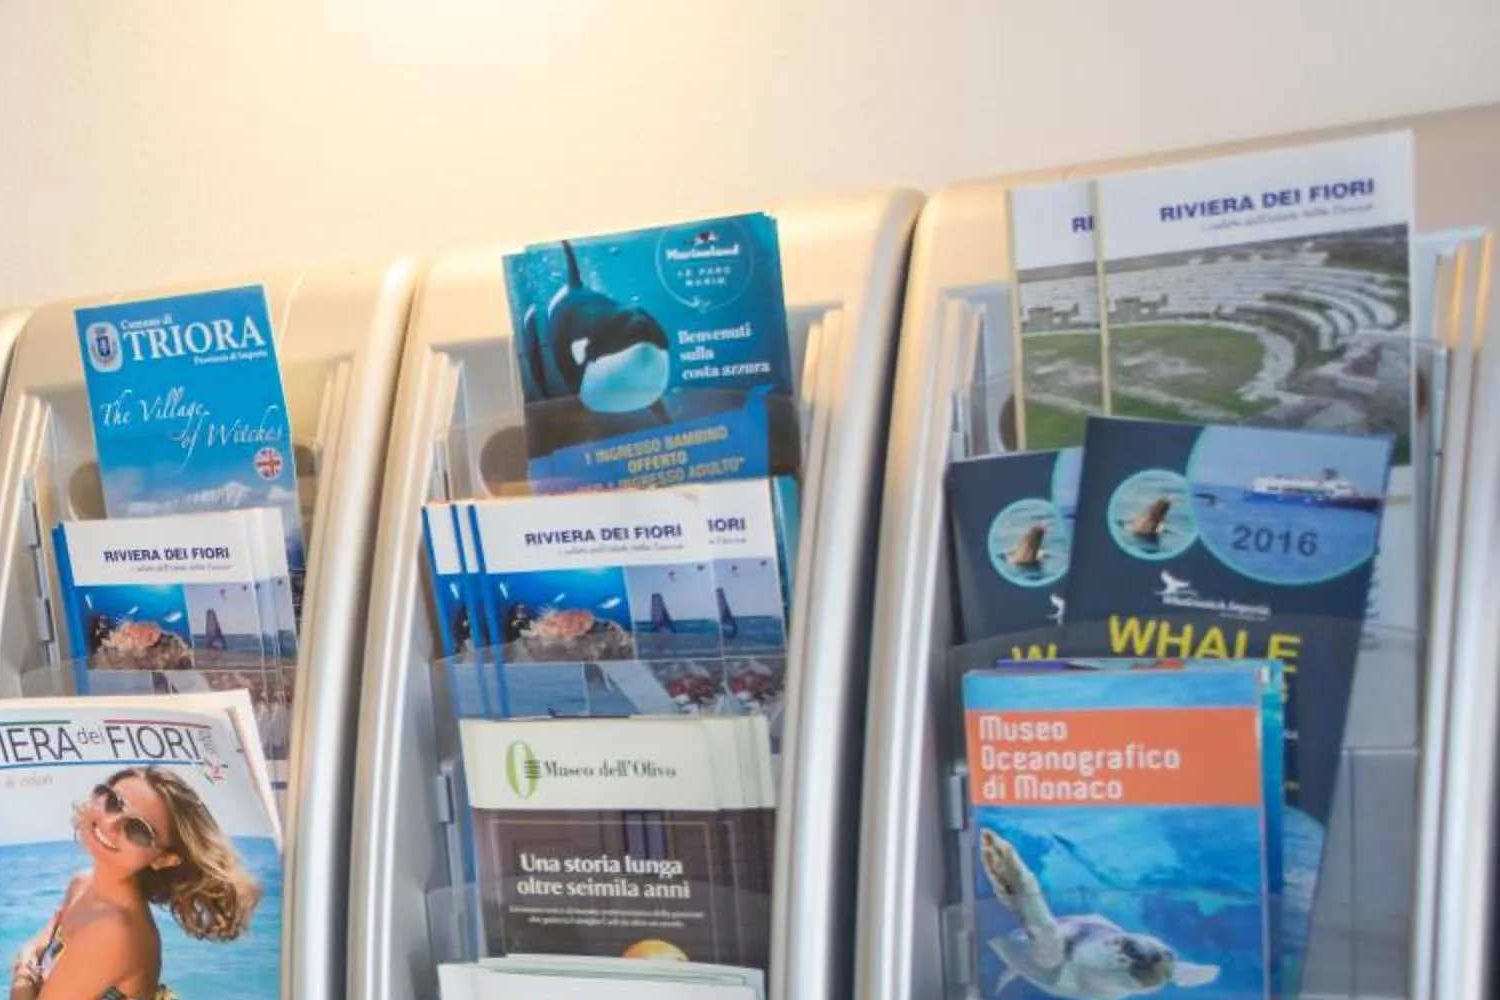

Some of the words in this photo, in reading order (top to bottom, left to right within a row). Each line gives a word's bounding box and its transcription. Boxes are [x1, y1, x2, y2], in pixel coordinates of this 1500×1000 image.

[1160, 195, 1255, 222] RIVIERA
[1262, 189, 1302, 209] DEI
[1309, 177, 1376, 201] FIORI
[666, 244, 742, 261] Marineland
[123, 316, 266, 361] TRIORA
[677, 321, 752, 344] Benvenuti
[679, 346, 715, 361] sulla
[681, 366, 720, 380] costa
[101, 389, 133, 426] The
[140, 386, 210, 428] Village
[208, 405, 282, 447] Witches
[525, 530, 596, 546] RIVIERA
[600, 527, 629, 542] DEI
[634, 523, 682, 540] FIORI
[708, 517, 746, 533] IORI
[1232, 524, 1318, 557] 2016
[104, 548, 162, 563] RIVIERA
[165, 549, 188, 561] DEI
[192, 547, 230, 560] FIORI
[980, 715, 1068, 742] Museo
[77, 726, 105, 746] dei
[105, 725, 201, 761] FIORI
[542, 761, 595, 777] Museo
[981, 745, 1181, 776] Oceanografico
[984, 777, 1006, 799] di
[1015, 774, 1123, 800] Monaco
[520, 854, 561, 874] Una
[564, 855, 621, 874] storia
[624, 855, 684, 879] lunga
[516, 877, 563, 896] oltre
[567, 879, 640, 898] seimila
[644, 880, 692, 900] anni
